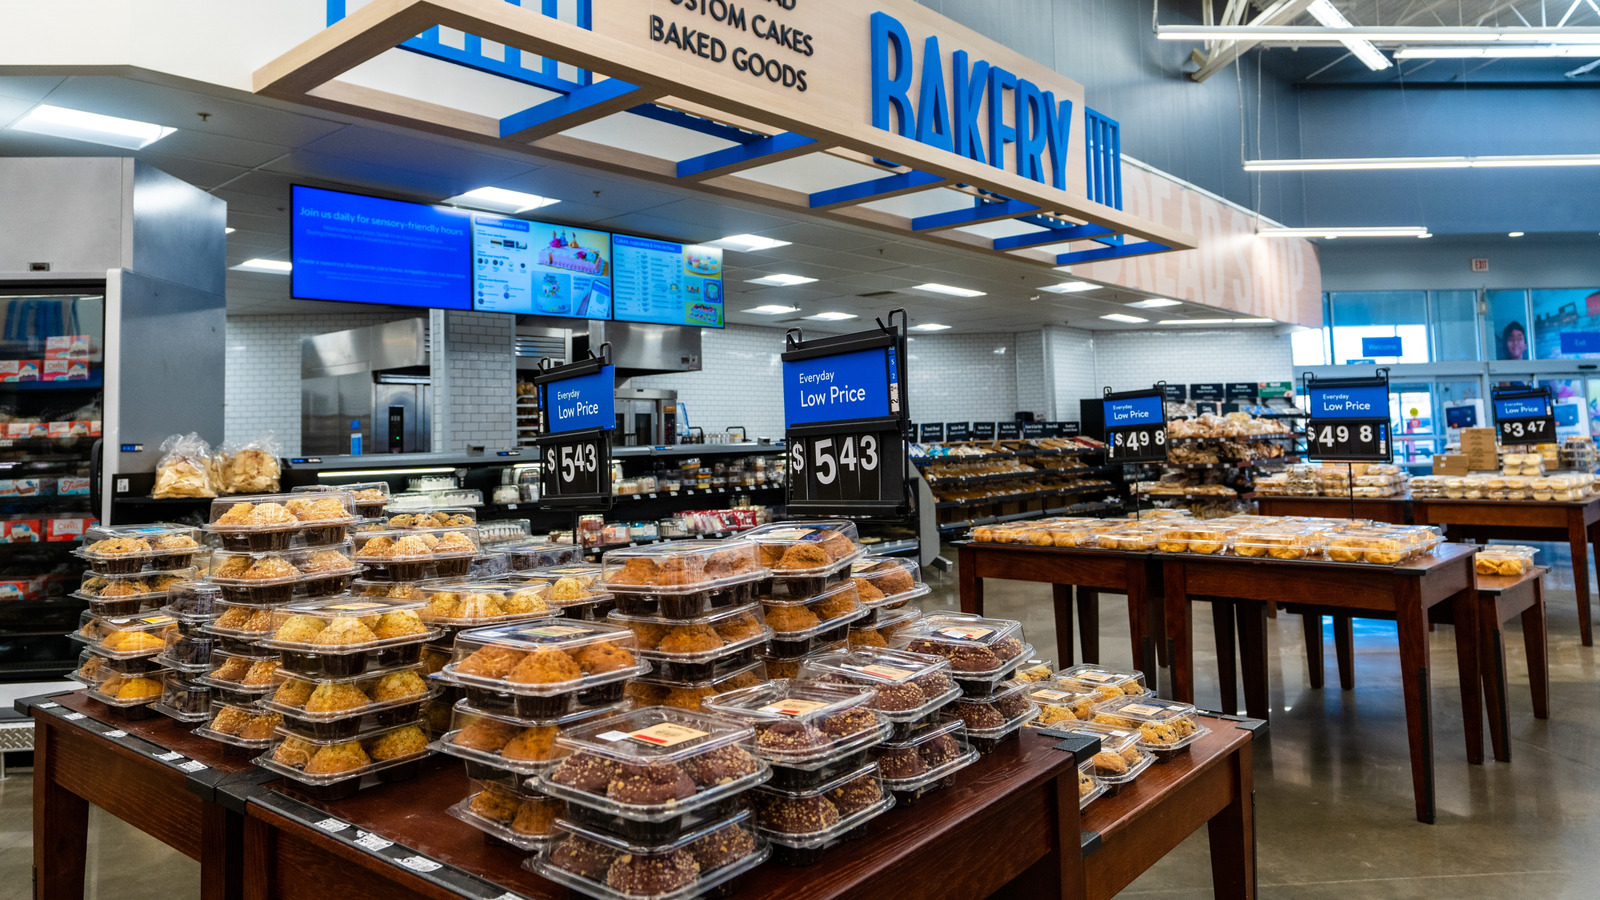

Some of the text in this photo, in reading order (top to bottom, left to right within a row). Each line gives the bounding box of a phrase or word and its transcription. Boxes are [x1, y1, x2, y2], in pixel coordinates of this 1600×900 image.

[752, 14, 814, 57] CAKES
[650, 14, 808, 92] BAKED GOODS
[870, 11, 1073, 192] BAKERY
[300, 207, 464, 236] Join us daily for sensory-friendly hours
[1475, 260, 1486, 270] EXIT
[799, 370, 834, 384] Everyday
[558, 389, 580, 400] Everyday
[800, 385, 866, 407] Low Price
[558, 401, 598, 419] Low Price
[1130, 410, 1149, 418] Price
[1324, 401, 1370, 411] Low Price
